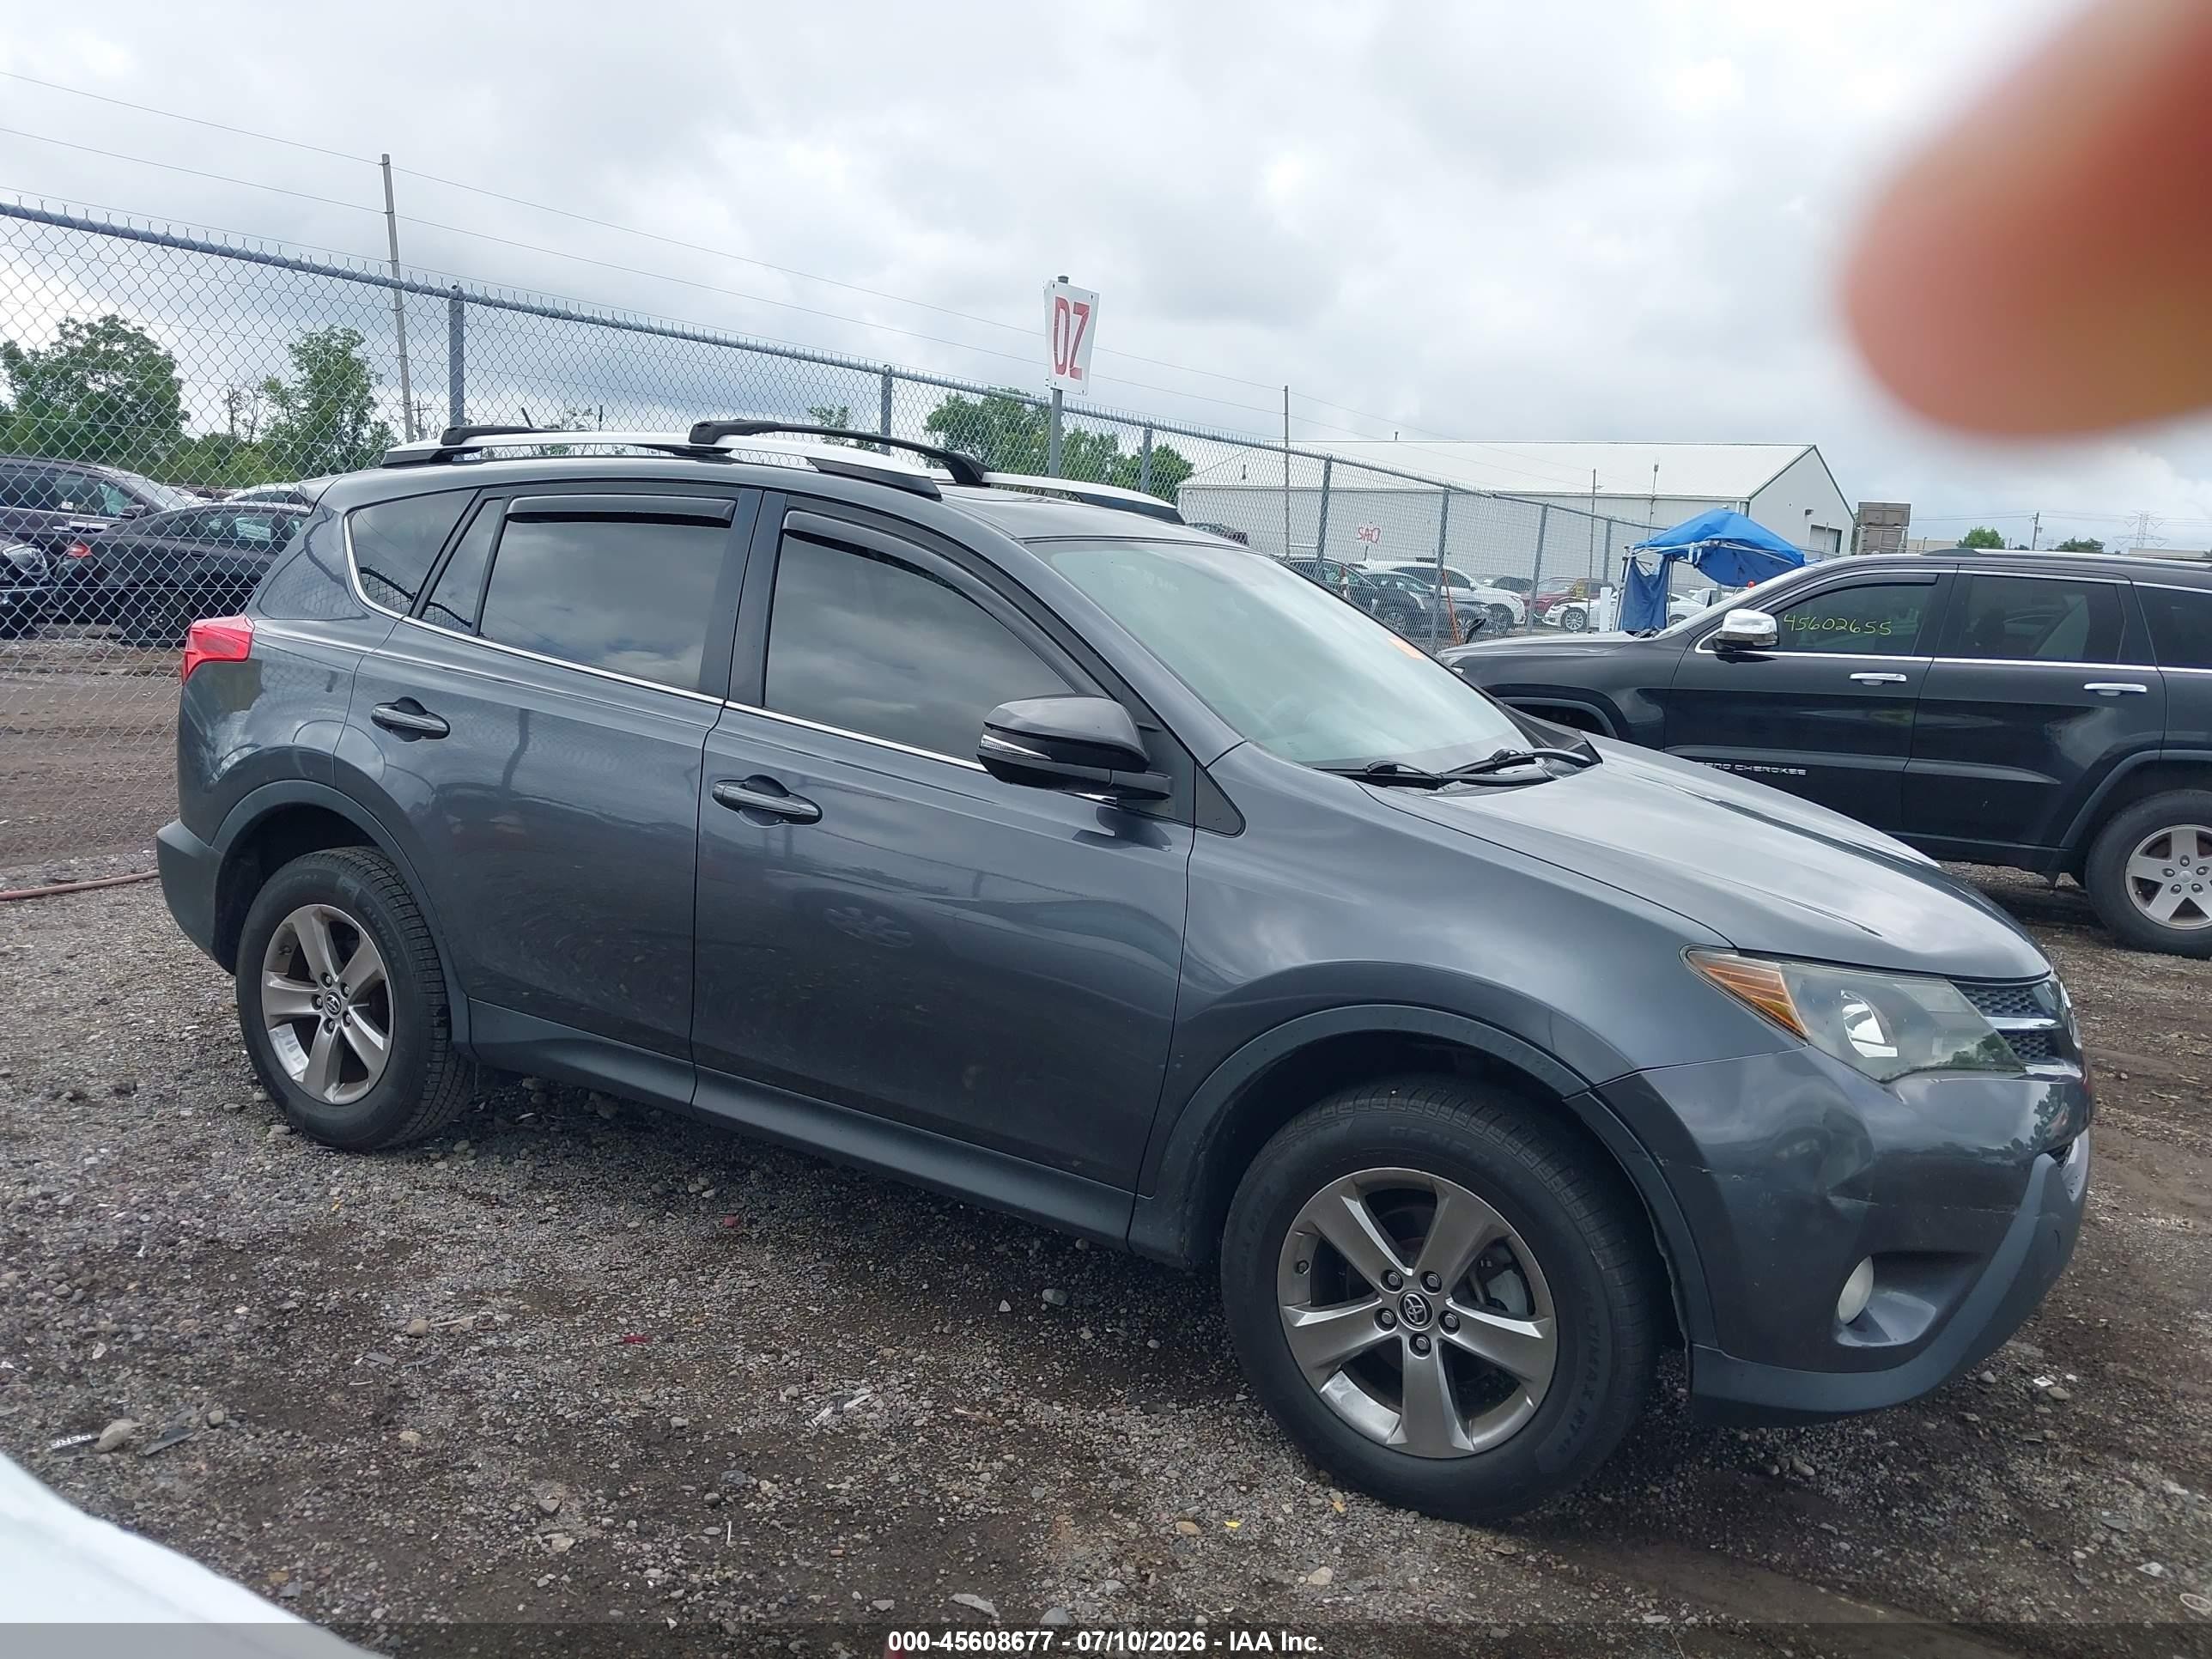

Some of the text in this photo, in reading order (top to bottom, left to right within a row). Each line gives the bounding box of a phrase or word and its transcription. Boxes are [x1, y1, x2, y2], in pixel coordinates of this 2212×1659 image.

[1053, 295, 1091, 380] DZ
[1783, 614, 1893, 635] 45602655
[1735, 764, 1807, 775] CHEROKEE
